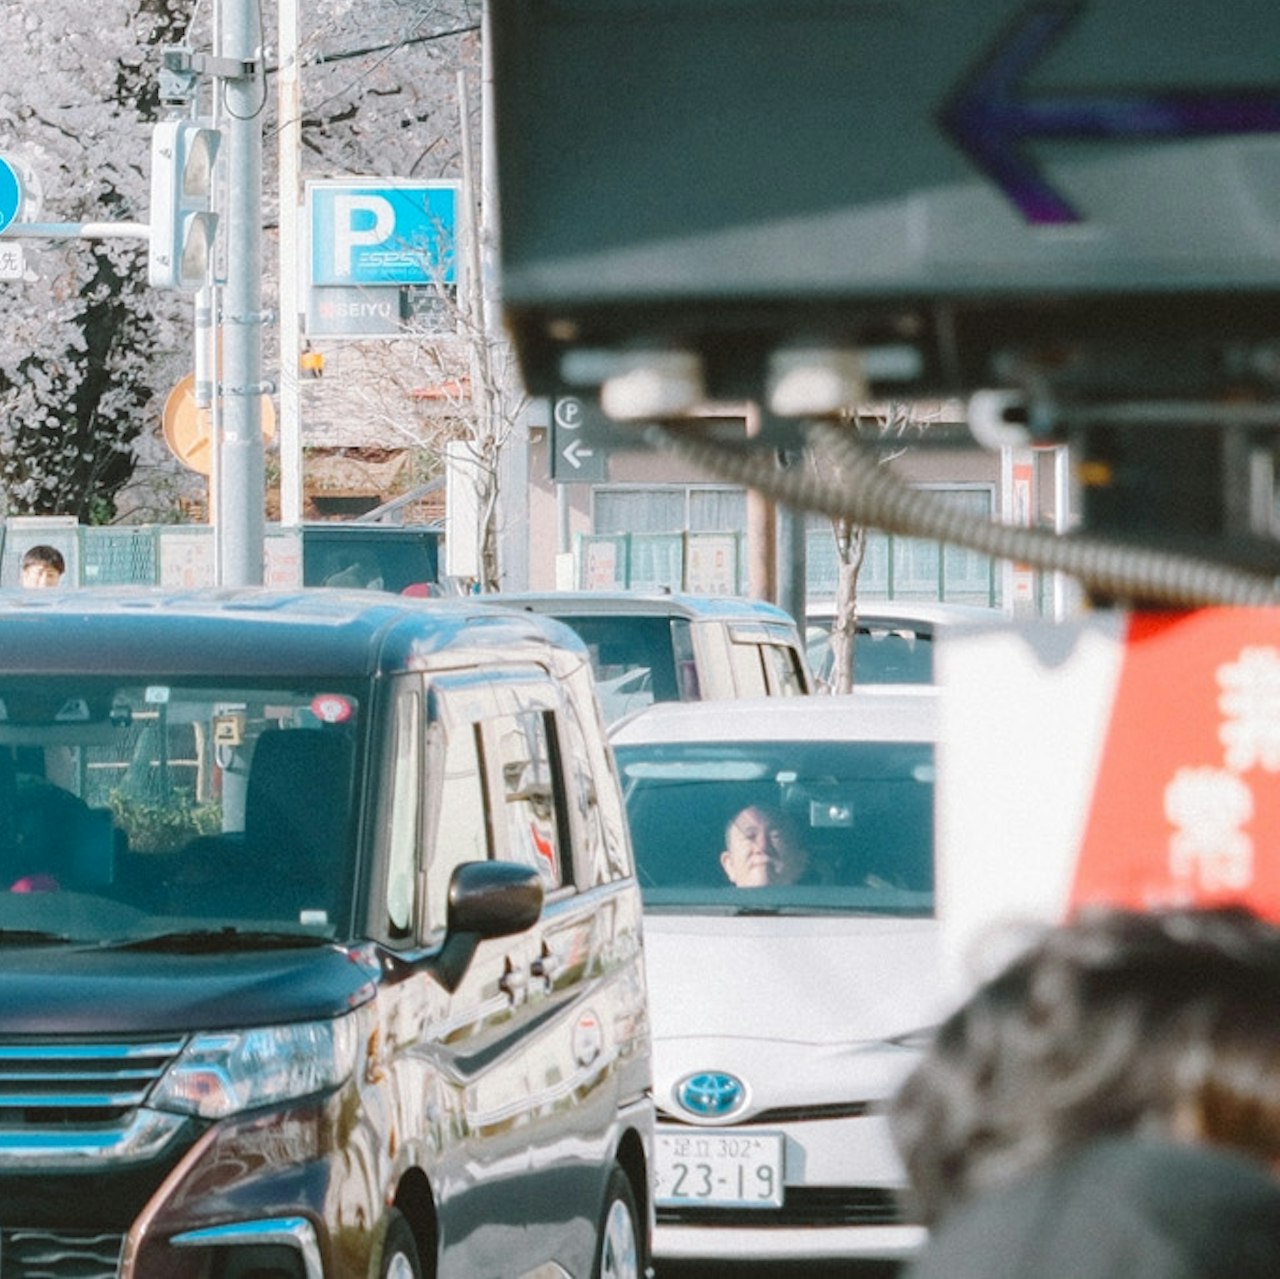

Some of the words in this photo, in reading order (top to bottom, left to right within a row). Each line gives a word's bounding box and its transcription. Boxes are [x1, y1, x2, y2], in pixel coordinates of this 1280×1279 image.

[334, 194, 396, 277] P
[335, 302, 390, 318] SEIYU
[671, 1162, 775, 1199] 23-19
